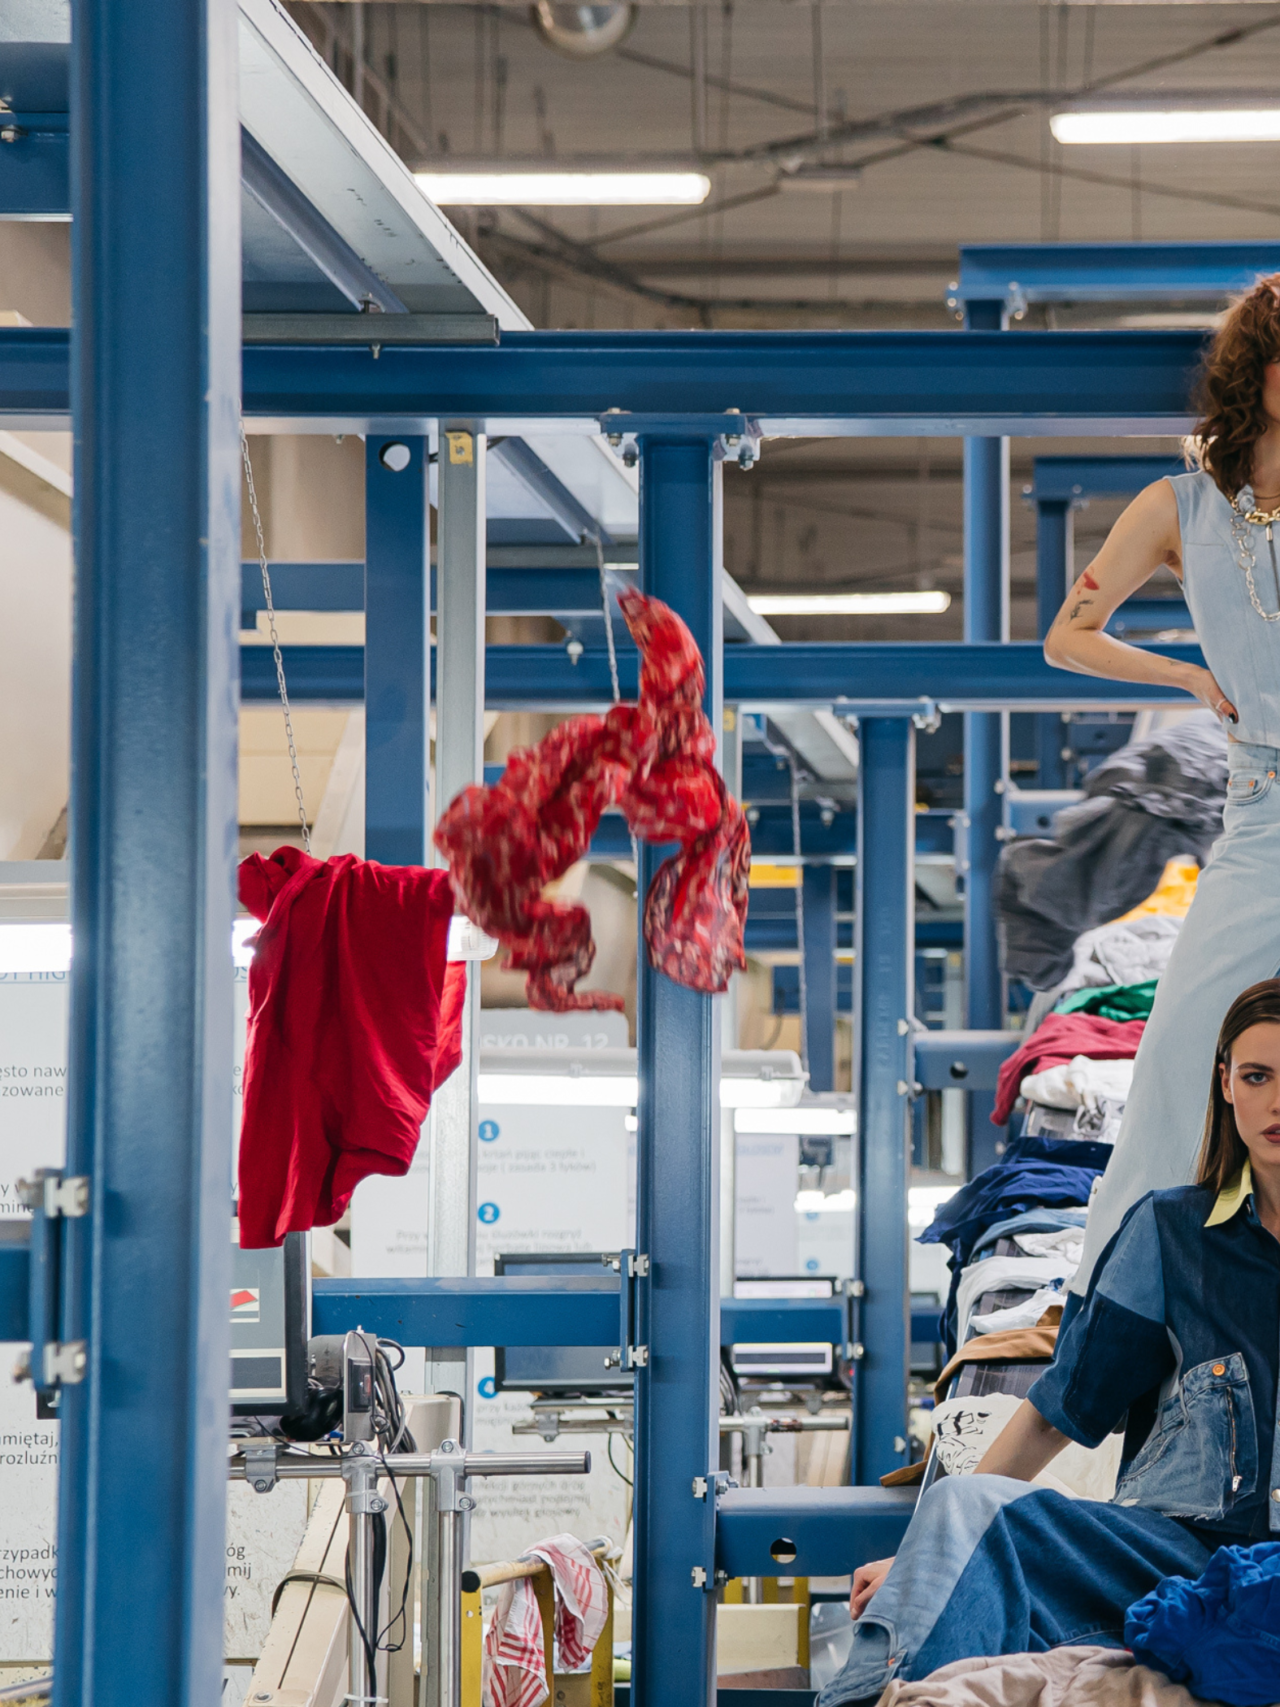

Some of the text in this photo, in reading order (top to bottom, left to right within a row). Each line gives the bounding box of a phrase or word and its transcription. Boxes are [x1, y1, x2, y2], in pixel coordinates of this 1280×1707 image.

[0, 1064, 28, 1081] sto
[0, 1431, 58, 1448] miętaj,
[0, 1544, 59, 1563] zypadk
